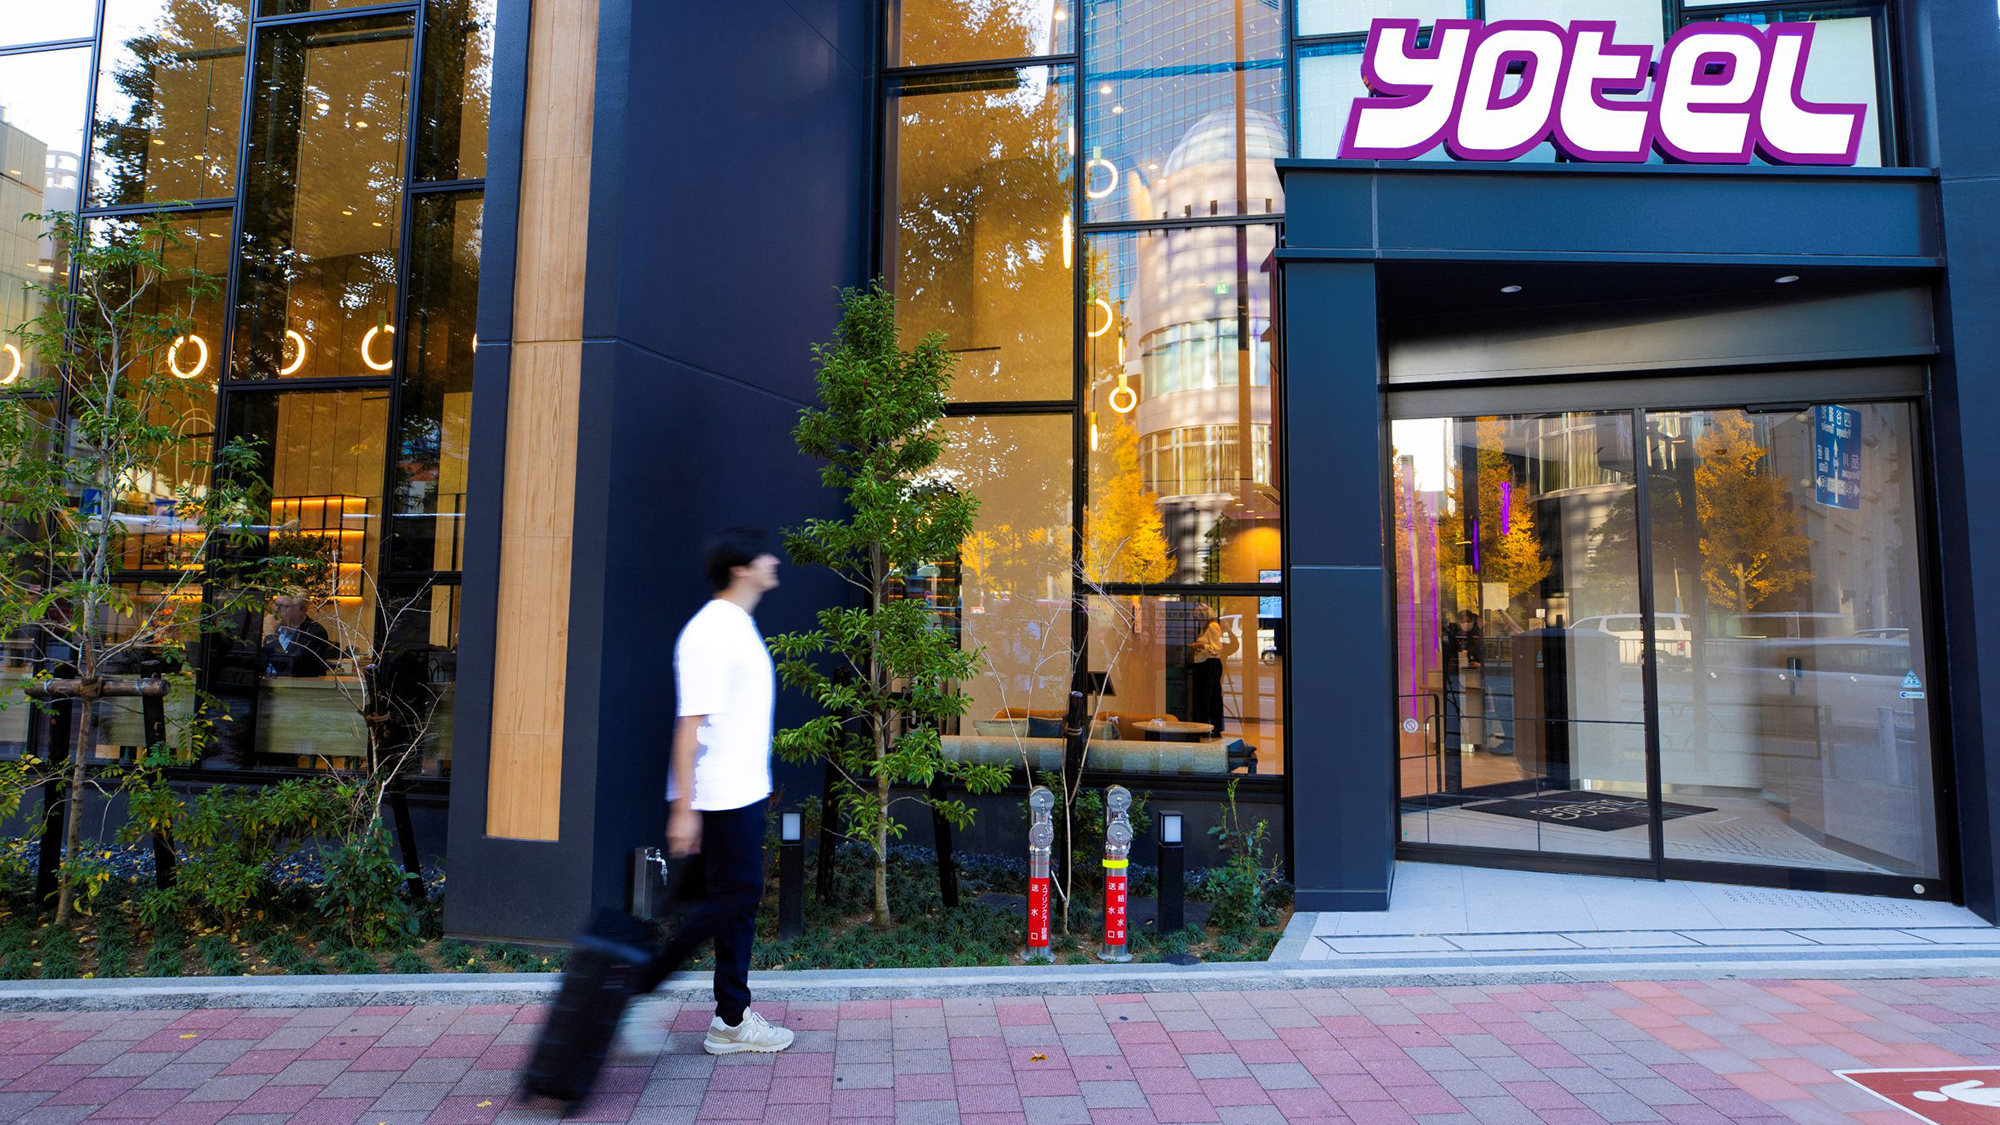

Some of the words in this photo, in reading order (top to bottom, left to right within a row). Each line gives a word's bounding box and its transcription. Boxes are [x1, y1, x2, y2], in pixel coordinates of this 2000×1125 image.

[1030, 884, 1039, 940] 送水口
[1108, 882, 1116, 938] 送水口
